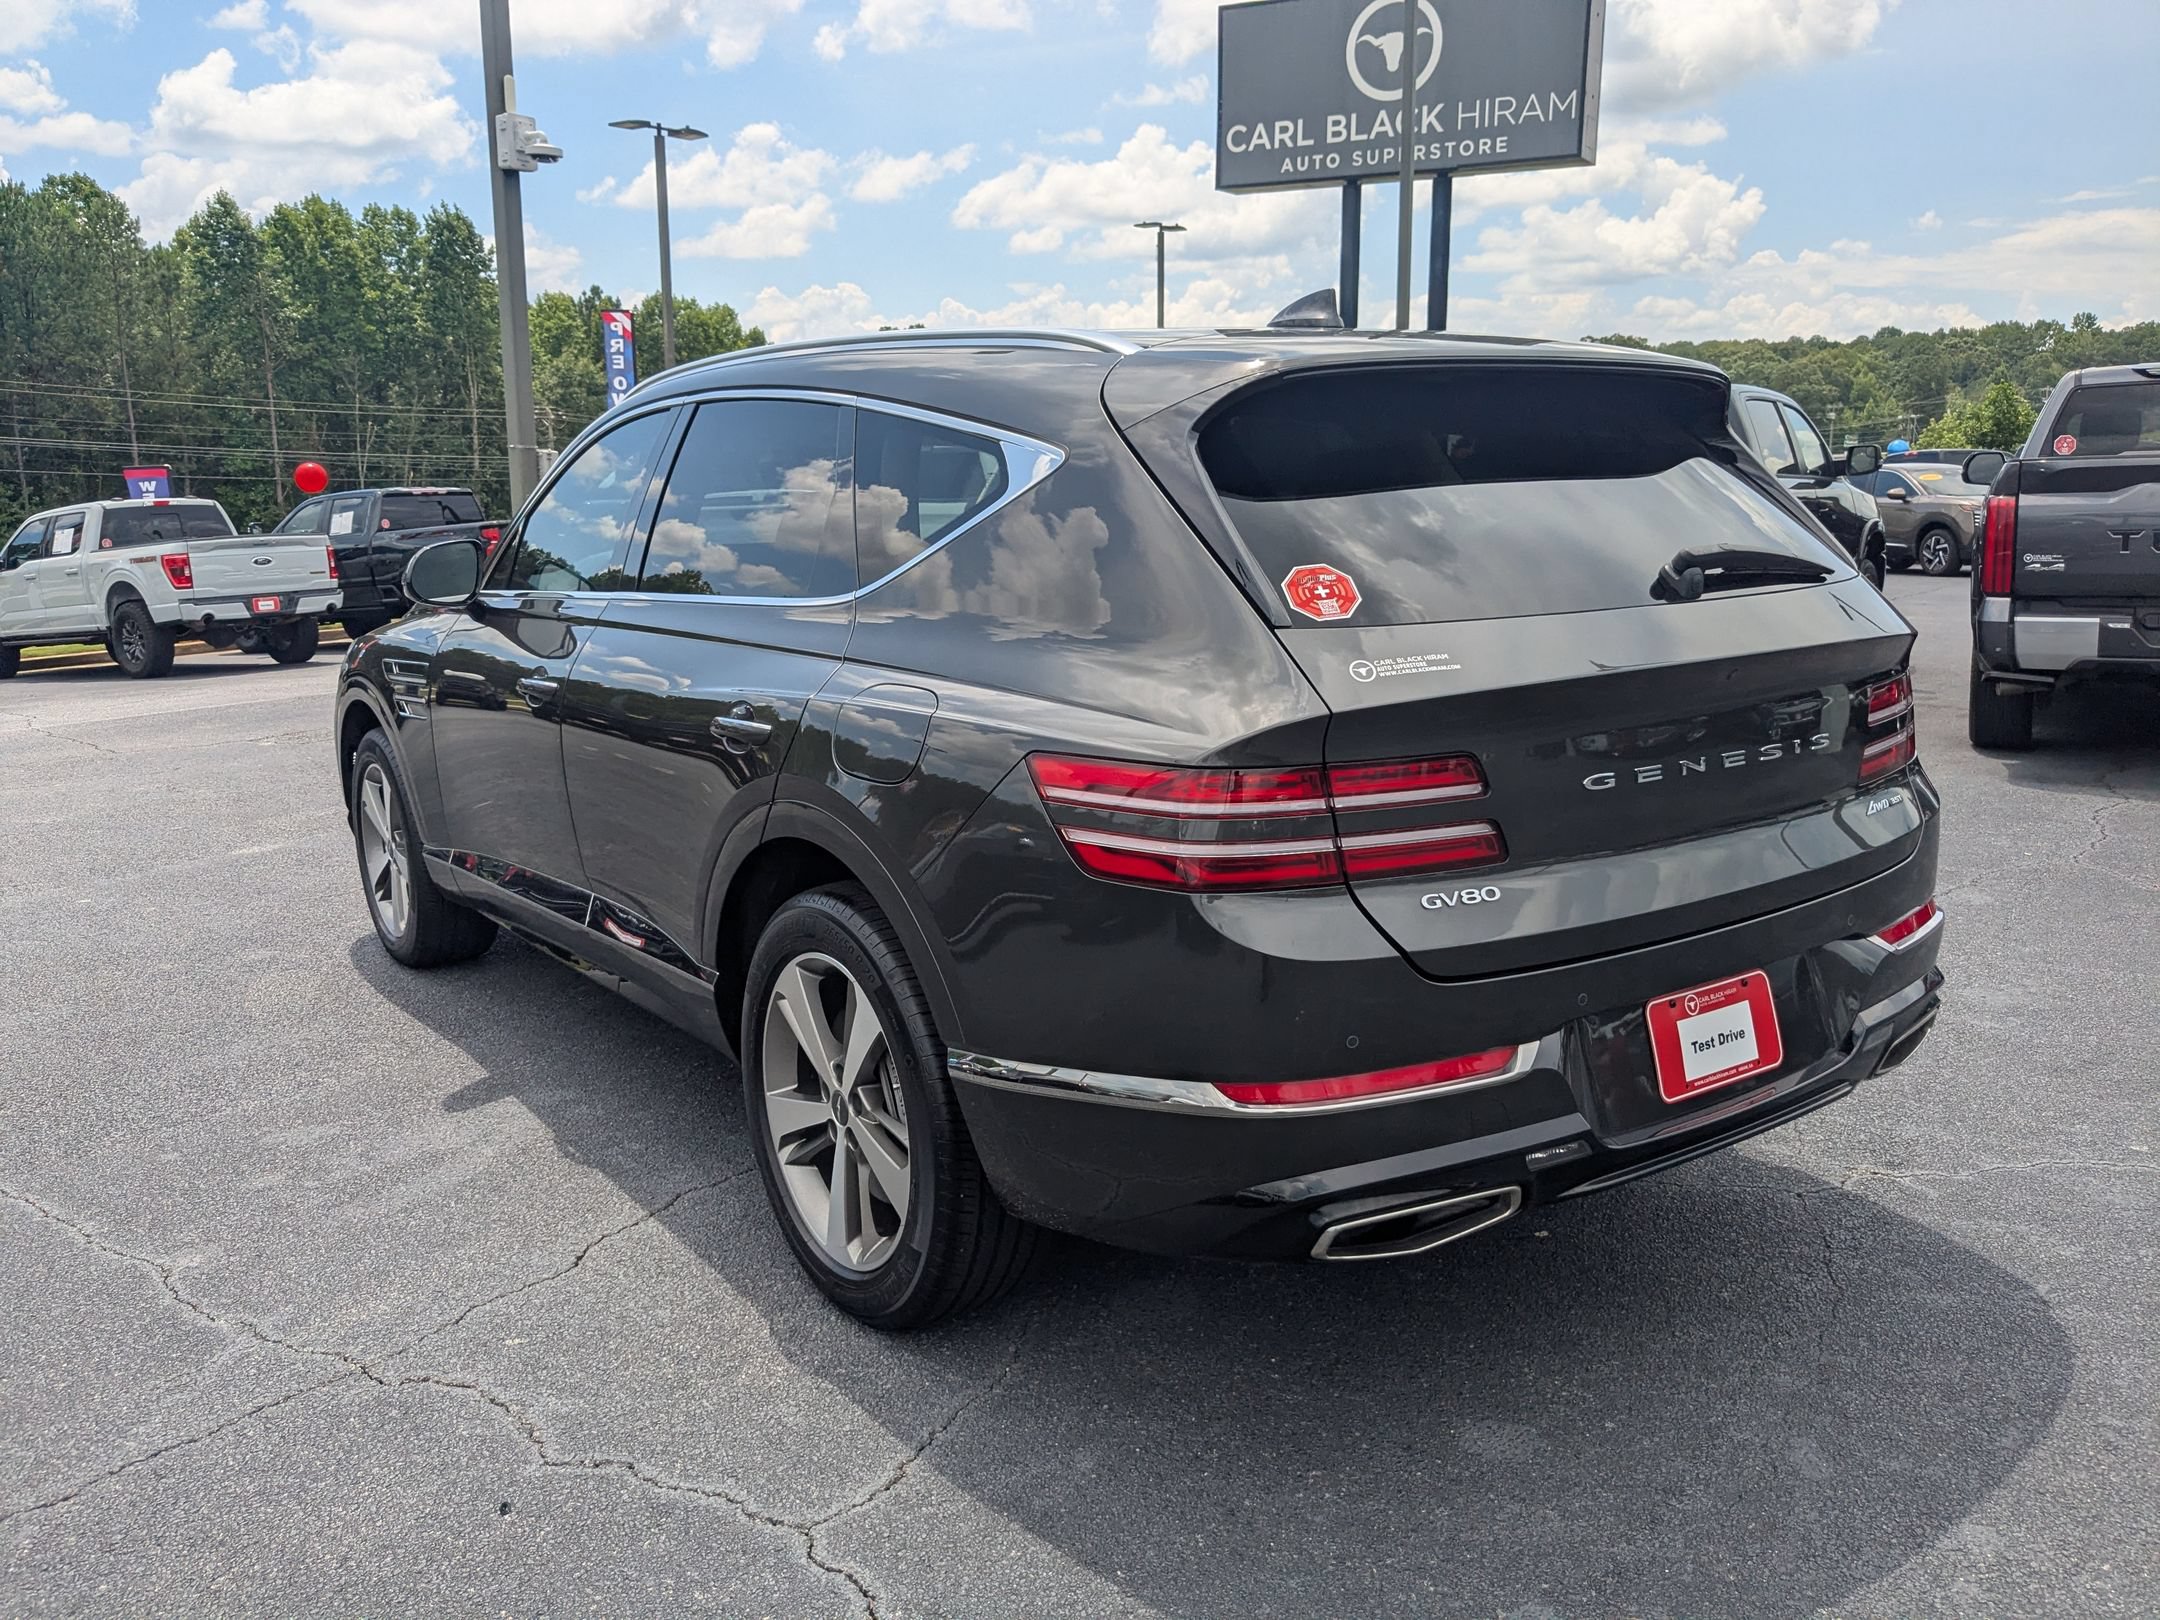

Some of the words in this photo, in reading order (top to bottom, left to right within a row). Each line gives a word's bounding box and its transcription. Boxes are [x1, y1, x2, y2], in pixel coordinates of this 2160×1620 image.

[1226, 118, 1315, 153] CARL
[1457, 89, 1578, 131] HIRAM
[1280, 152, 1341, 174] AUTO
[1352, 136, 1509, 168] SUPRSTORE
[1373, 658, 1396, 667] CARL
[1396, 655, 1423, 664] BLACK
[1424, 653, 1449, 662] HIRAM
[1377, 665, 1391, 673] AUTO
[1393, 661, 1428, 670] SUPERSTORE
[1583, 732, 1831, 791] GENESIS
[1421, 885, 1501, 910] GV80
[1691, 1036, 1716, 1054] Test
[1718, 1028, 1746, 1046] Drive
